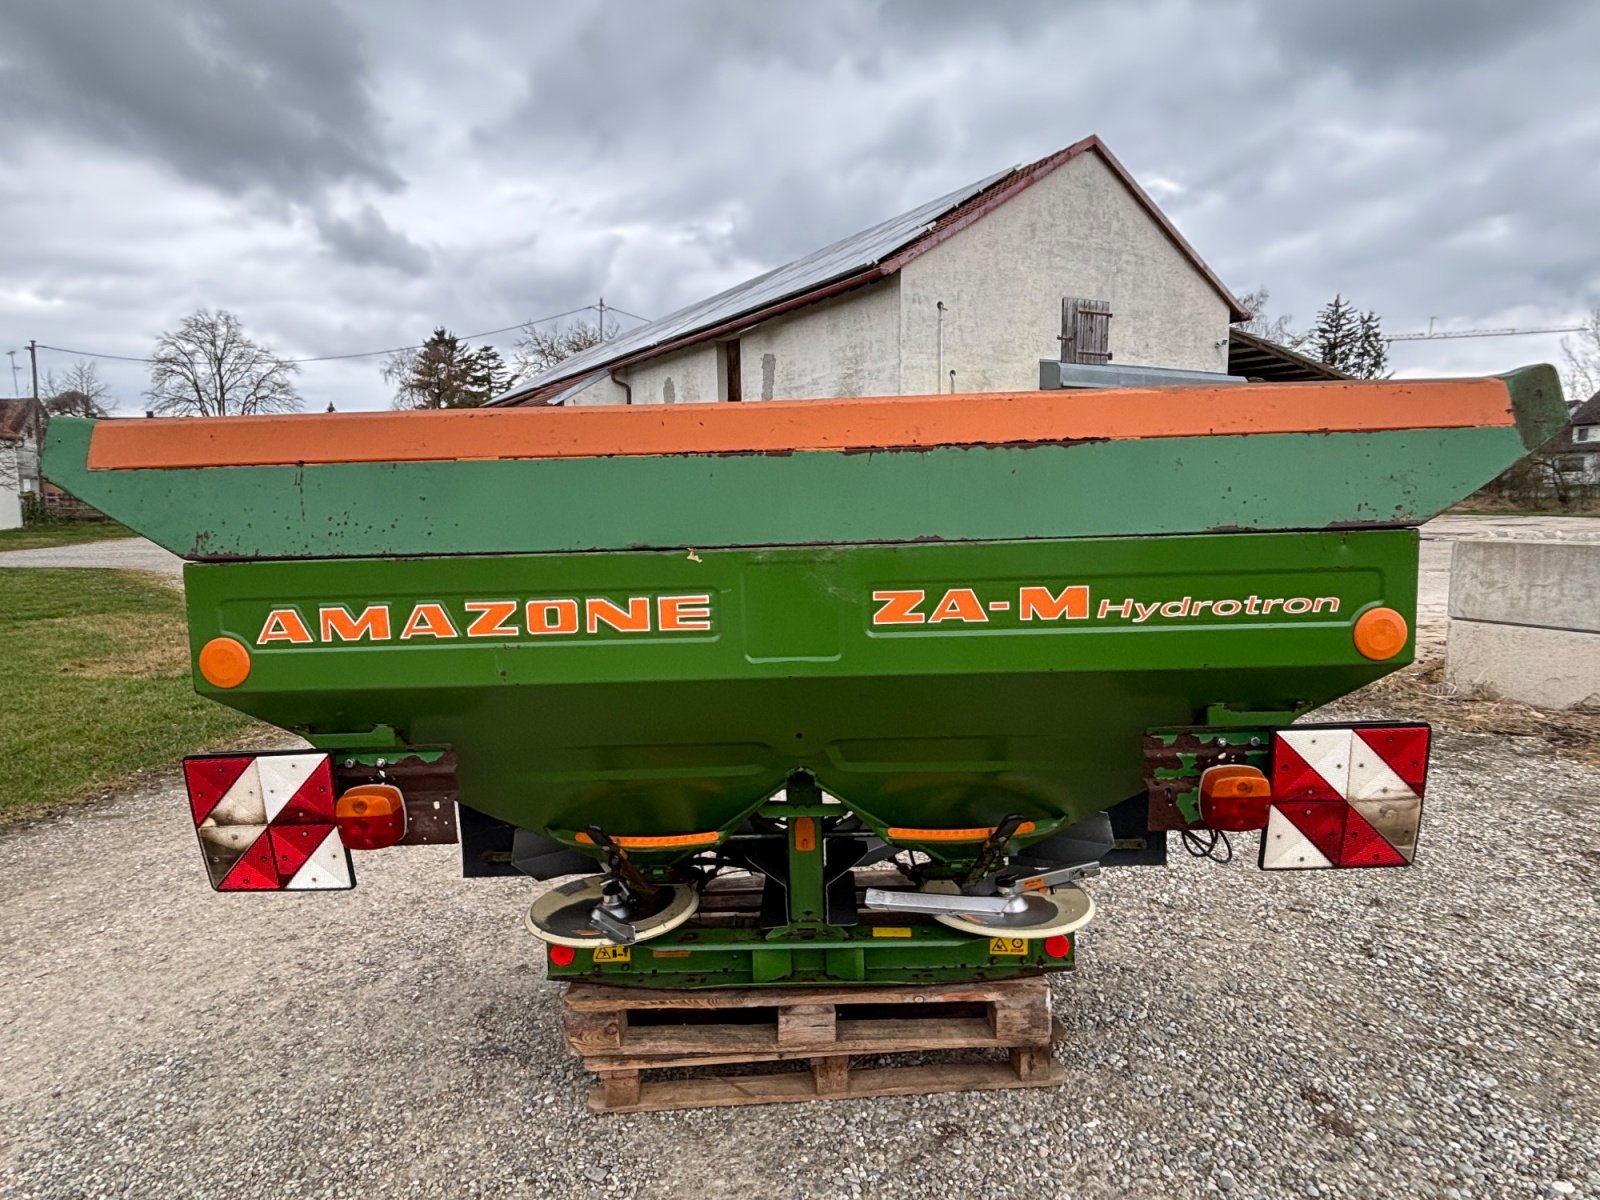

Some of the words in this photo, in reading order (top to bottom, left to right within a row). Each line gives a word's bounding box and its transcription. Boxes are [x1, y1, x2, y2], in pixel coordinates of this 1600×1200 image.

[256, 595, 711, 645] AMAZONE
[872, 585, 1090, 625] ZA-M
[1096, 595, 1341, 623] Hydrotron
